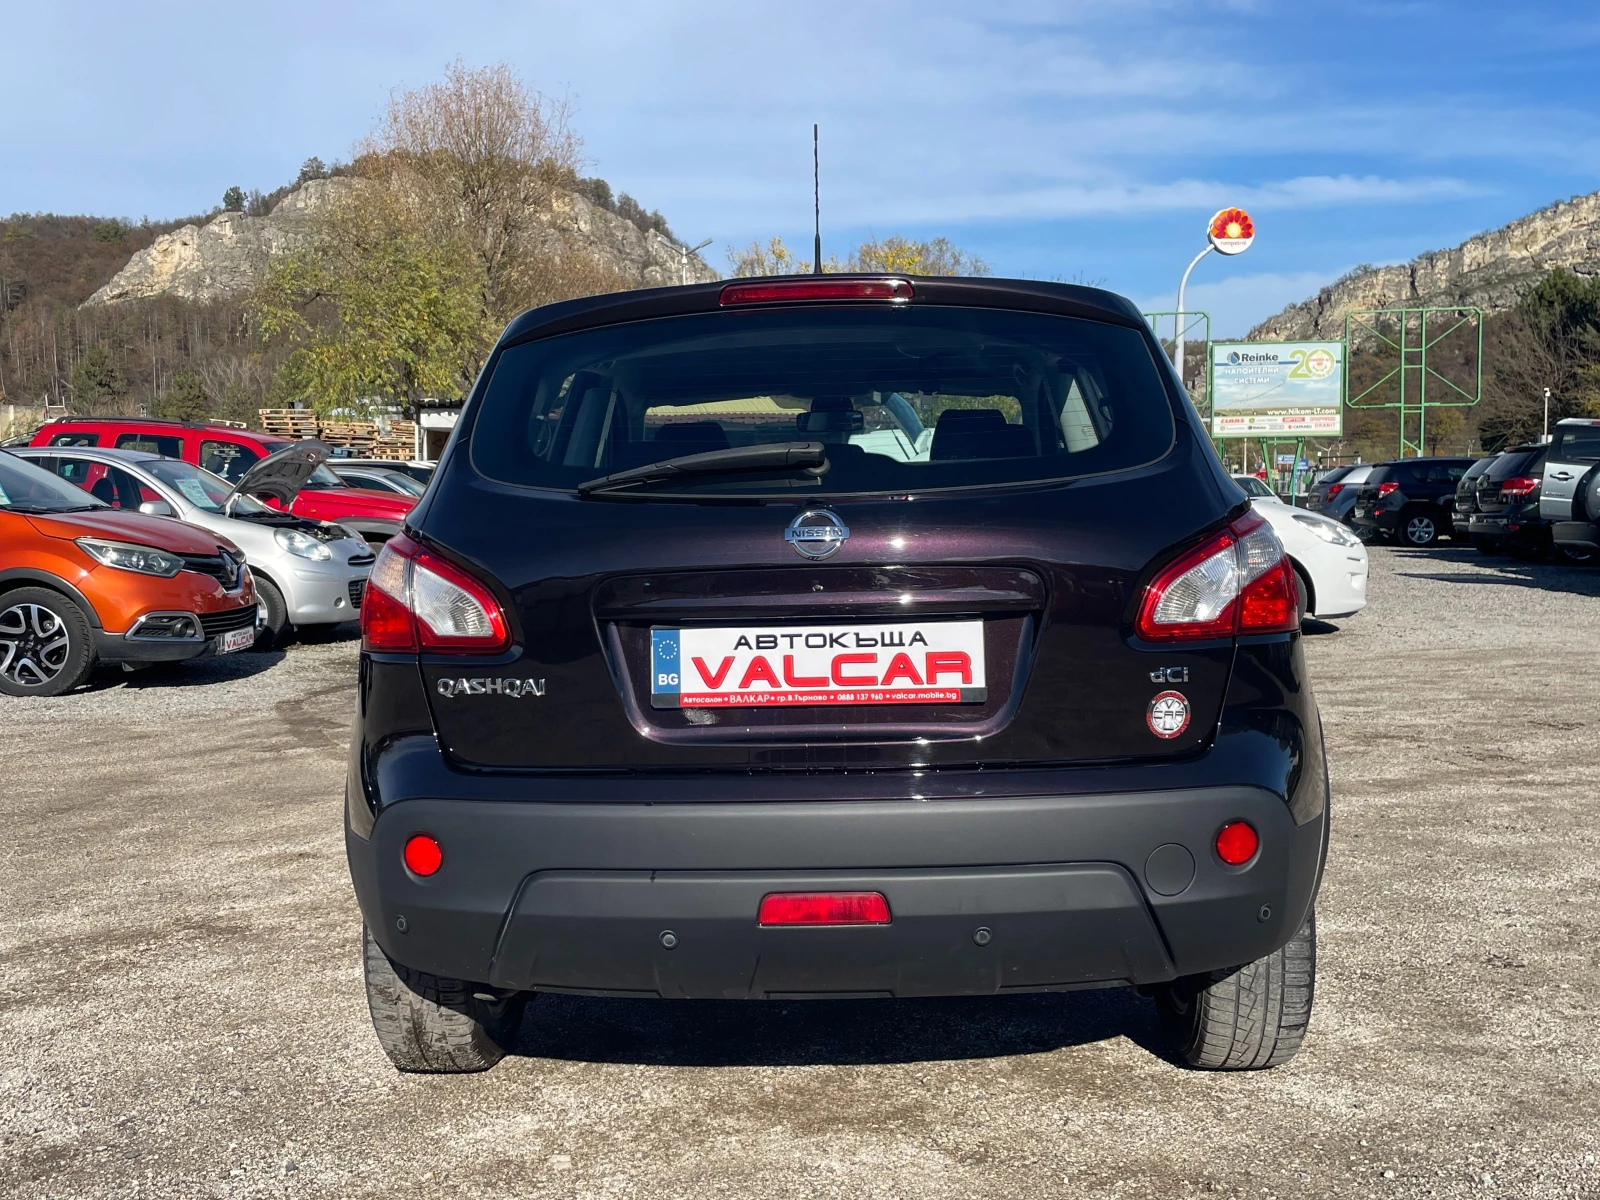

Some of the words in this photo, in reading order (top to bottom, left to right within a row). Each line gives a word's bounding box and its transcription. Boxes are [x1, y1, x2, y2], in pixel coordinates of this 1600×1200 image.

[1241, 353, 1279, 362] Reinke
[1225, 366, 1279, 375] НАПОИТЕЛНИ
[1288, 349, 1336, 380] 20
[1267, 408, 1336, 416] www.Nikom-LT.com
[791, 528, 843, 538] NISSAN
[733, 631, 929, 650] АВТОКЪЩА
[691, 651, 973, 690] VALCAR
[1149, 667, 1189, 683] dCi
[658, 673, 679, 686] BG
[437, 677, 546, 698] QASHQAI
[729, 694, 770, 703] ВАЛКАР
[837, 693, 855, 701] 0888
[856, 693, 869, 701] 137
[870, 693, 884, 701] 960
